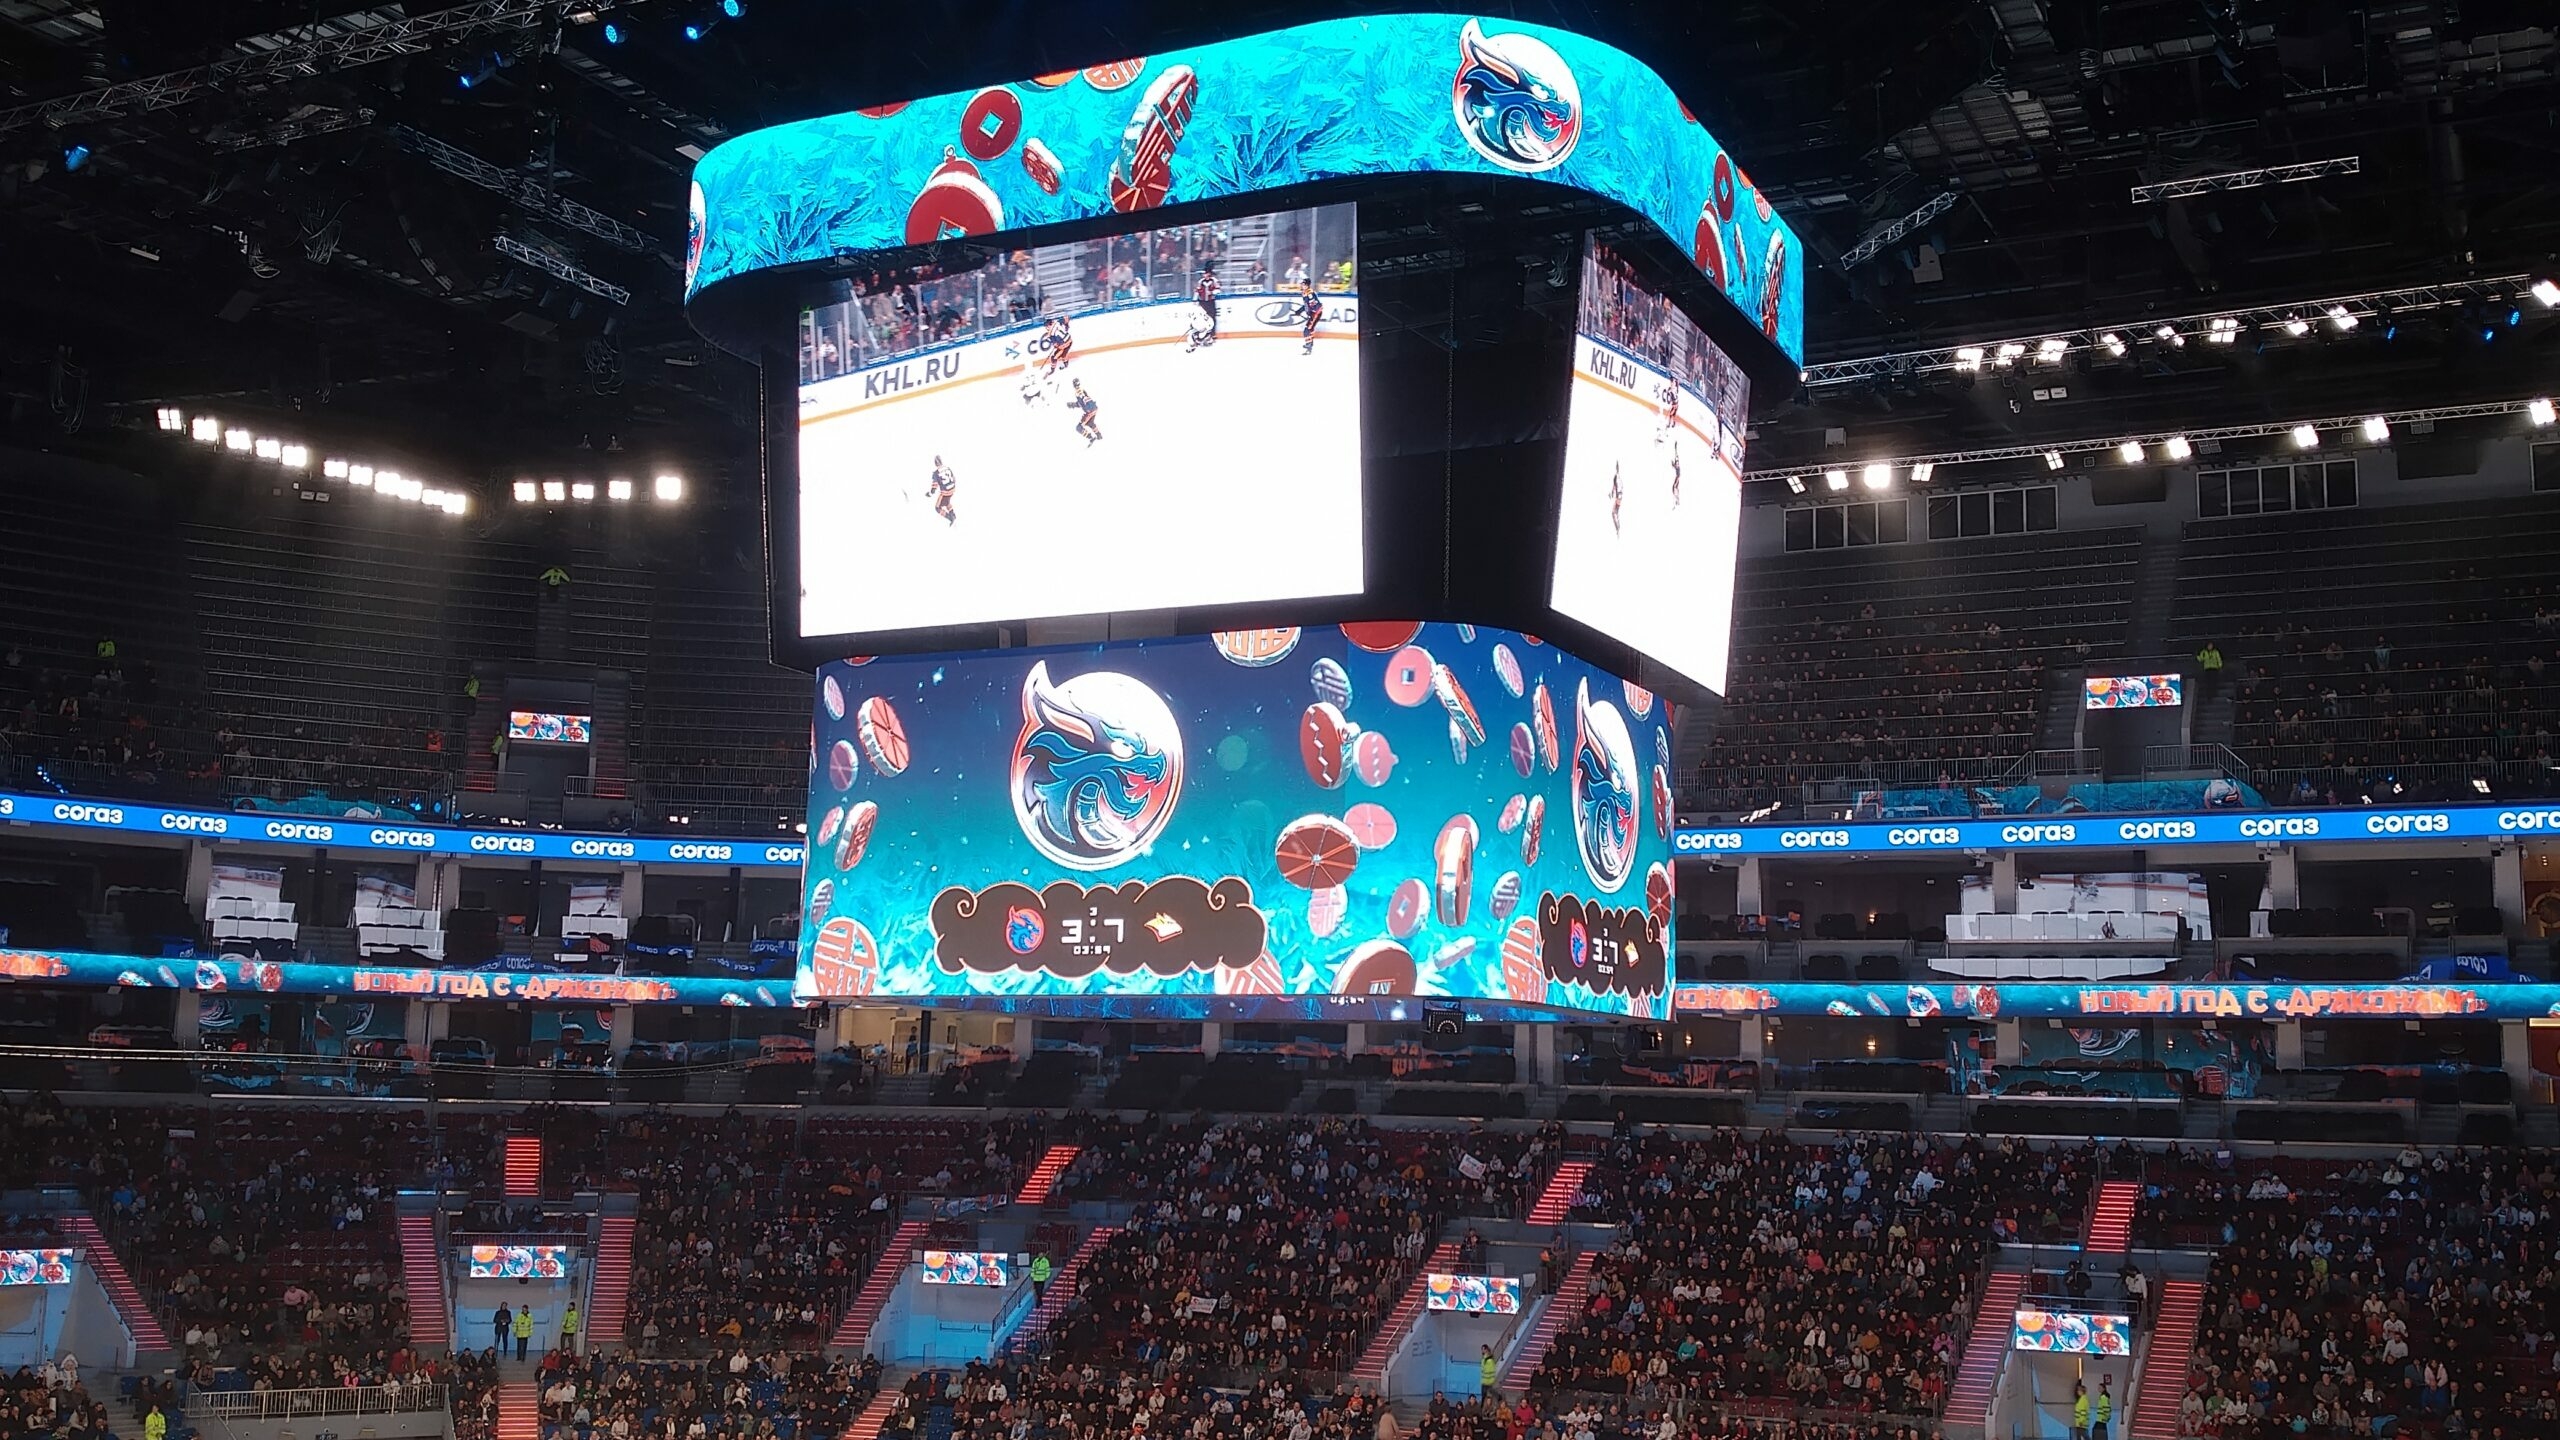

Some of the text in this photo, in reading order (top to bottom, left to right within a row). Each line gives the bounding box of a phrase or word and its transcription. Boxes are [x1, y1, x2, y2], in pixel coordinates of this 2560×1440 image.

[865, 352, 960, 399] KHL.RU
[1590, 348, 1637, 390] KHL.RU
[55, 804, 123, 824] согаз
[162, 814, 227, 833] согаз
[267, 823, 333, 841] согаз
[371, 830, 435, 847] согаз
[471, 836, 535, 852] согаз
[572, 841, 634, 857] согаз
[669, 844, 732, 860] согаз
[1676, 833, 1742, 850] согаз
[1780, 830, 1849, 848] согаз
[1888, 827, 1960, 845] согаз
[2003, 824, 2076, 843] согаз
[2119, 821, 2196, 840] согаз
[2240, 818, 2320, 836] согаз
[2366, 814, 2449, 833] согаз
[1089, 907, 1098, 916] 3
[1061, 919, 1124, 943] 3:7
[1592, 937, 1619, 965] 3:7
[353, 970, 434, 993] НОВЫЙ
[438, 974, 488, 998] ГОД
[494, 976, 511, 997] С
[2080, 985, 2174, 1014] НОВЫЙ
[2181, 989, 2242, 1016] ГОД
[2247, 990, 2268, 1013] С
